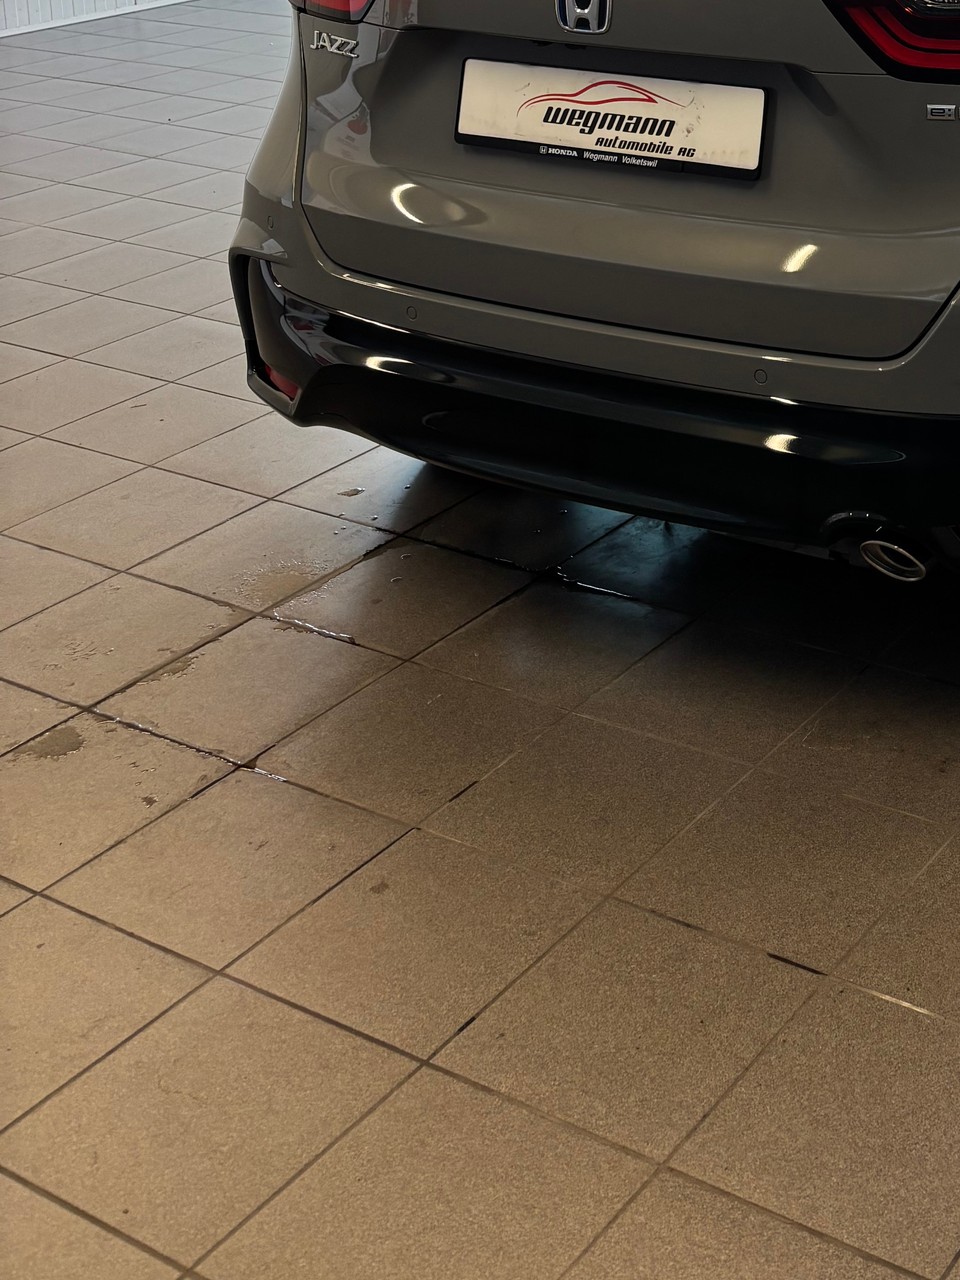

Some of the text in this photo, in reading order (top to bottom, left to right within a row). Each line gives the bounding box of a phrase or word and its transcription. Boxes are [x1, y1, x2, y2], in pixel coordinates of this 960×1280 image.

[310, 30, 358, 58] JAZZ
[542, 106, 676, 138] wegmann
[548, 147, 658, 168] HONDA Wegmann Volketswil
[595, 136, 697, 158] automobile AG
